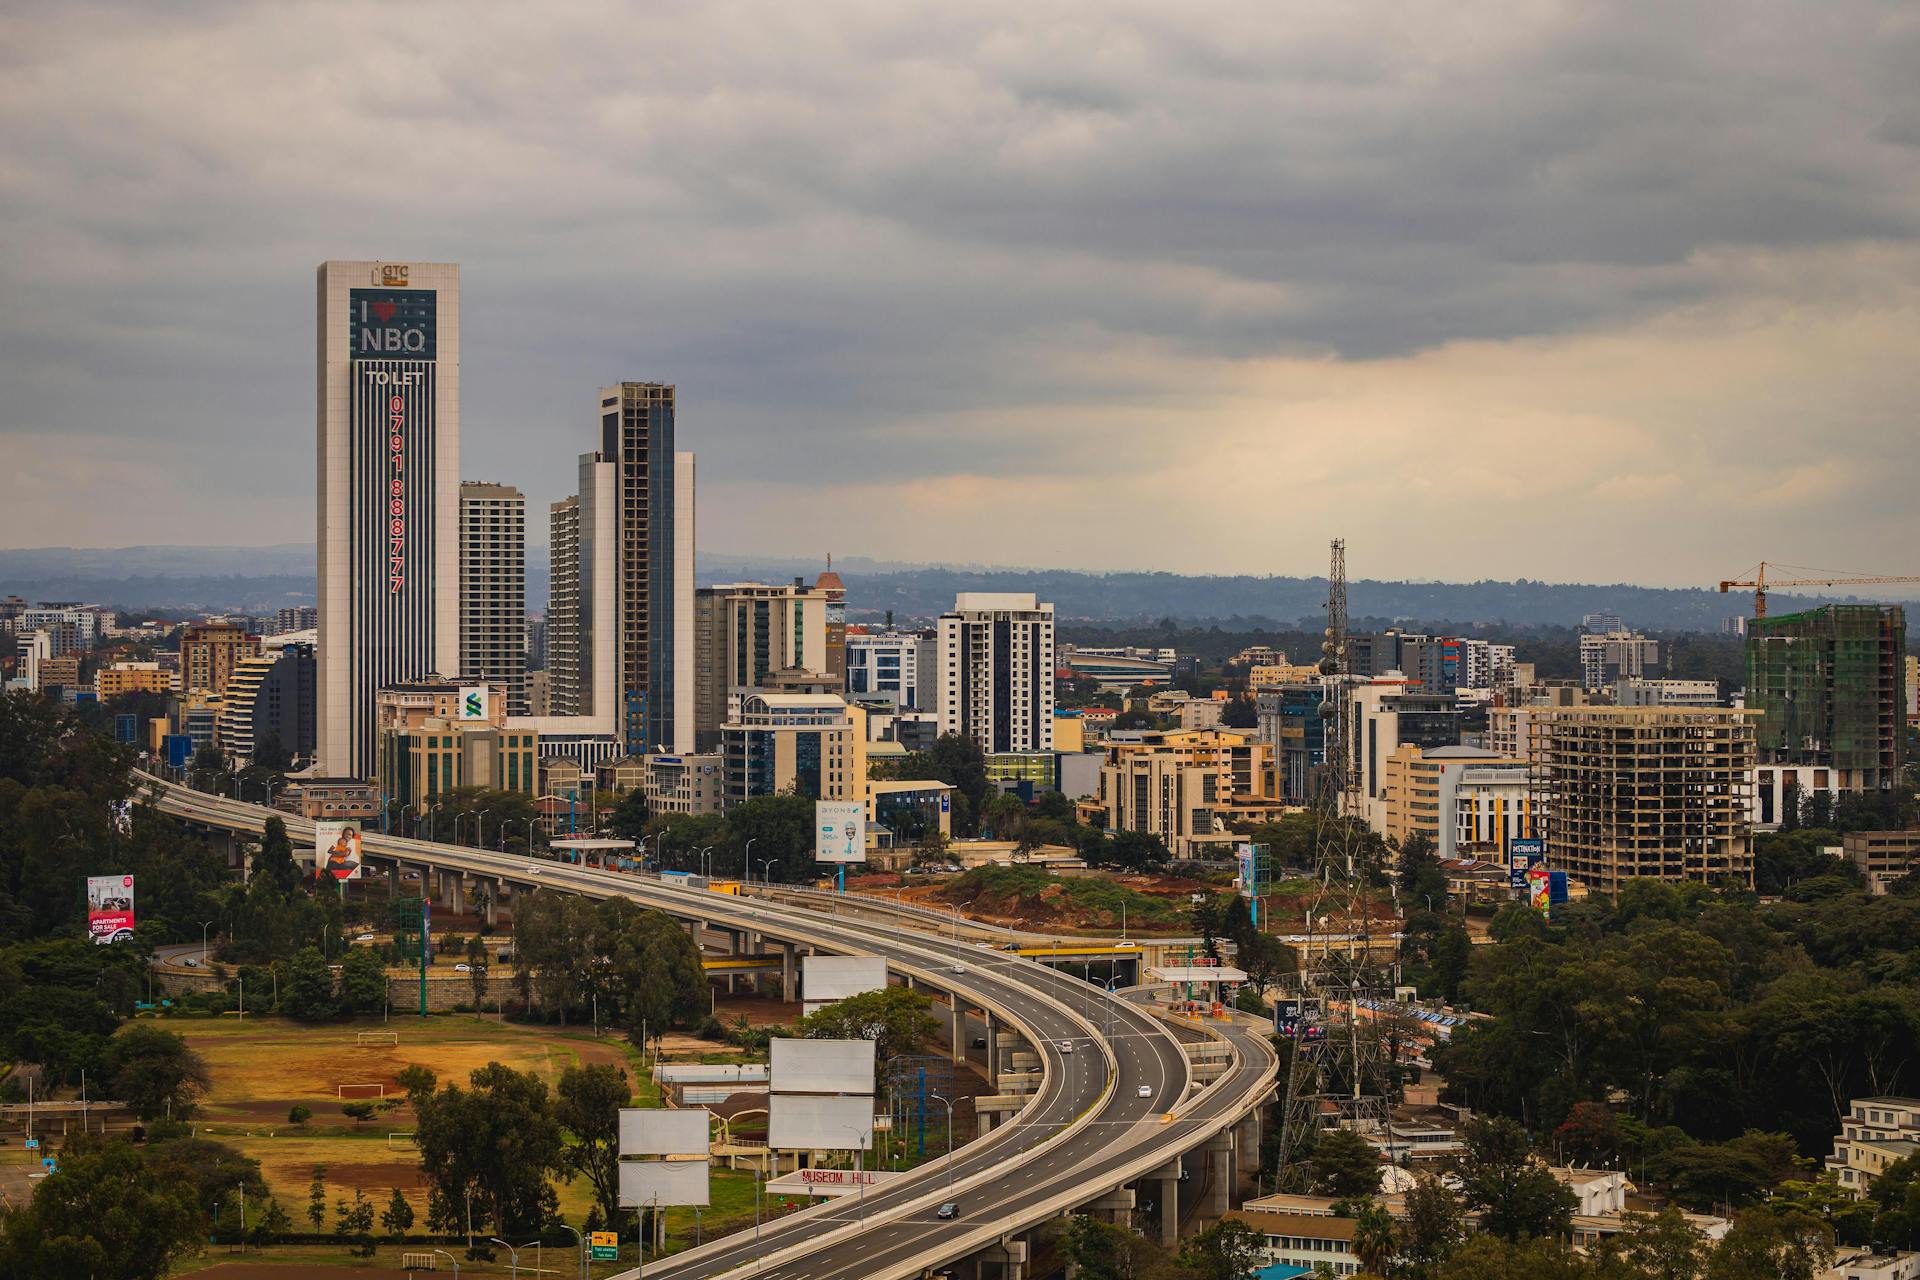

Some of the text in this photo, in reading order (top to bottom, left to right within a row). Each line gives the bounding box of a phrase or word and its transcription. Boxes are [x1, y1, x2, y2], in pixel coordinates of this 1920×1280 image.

[383, 265, 409, 277] GTC
[361, 300, 367, 323] I
[361, 327, 425, 352] NBO
[365, 371, 424, 386] TO LET
[1512, 845, 1541, 853] DESTINATION
[802, 1171, 843, 1183] MUSEUM
